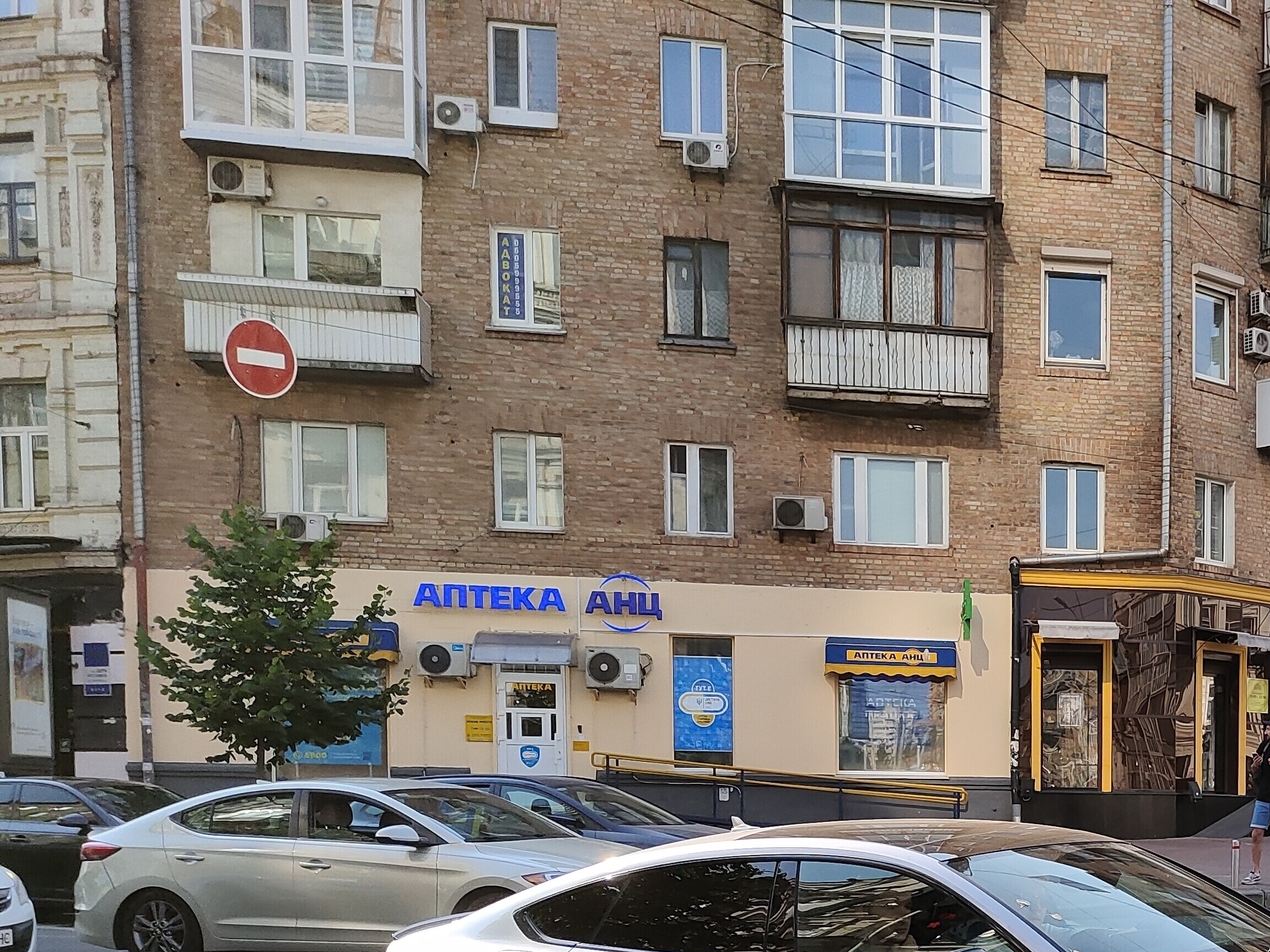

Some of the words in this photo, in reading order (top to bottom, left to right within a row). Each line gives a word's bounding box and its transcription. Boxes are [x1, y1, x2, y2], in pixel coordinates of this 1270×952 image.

[501, 237, 511, 316] АДВОКАТ
[413, 582, 567, 613] АПТЕКА
[584, 590, 663, 621] АНЦ
[853, 651, 897, 660] АПТЕКА
[901, 653, 924, 662] АНЦ
[511, 682, 553, 692] АПТЕКА
